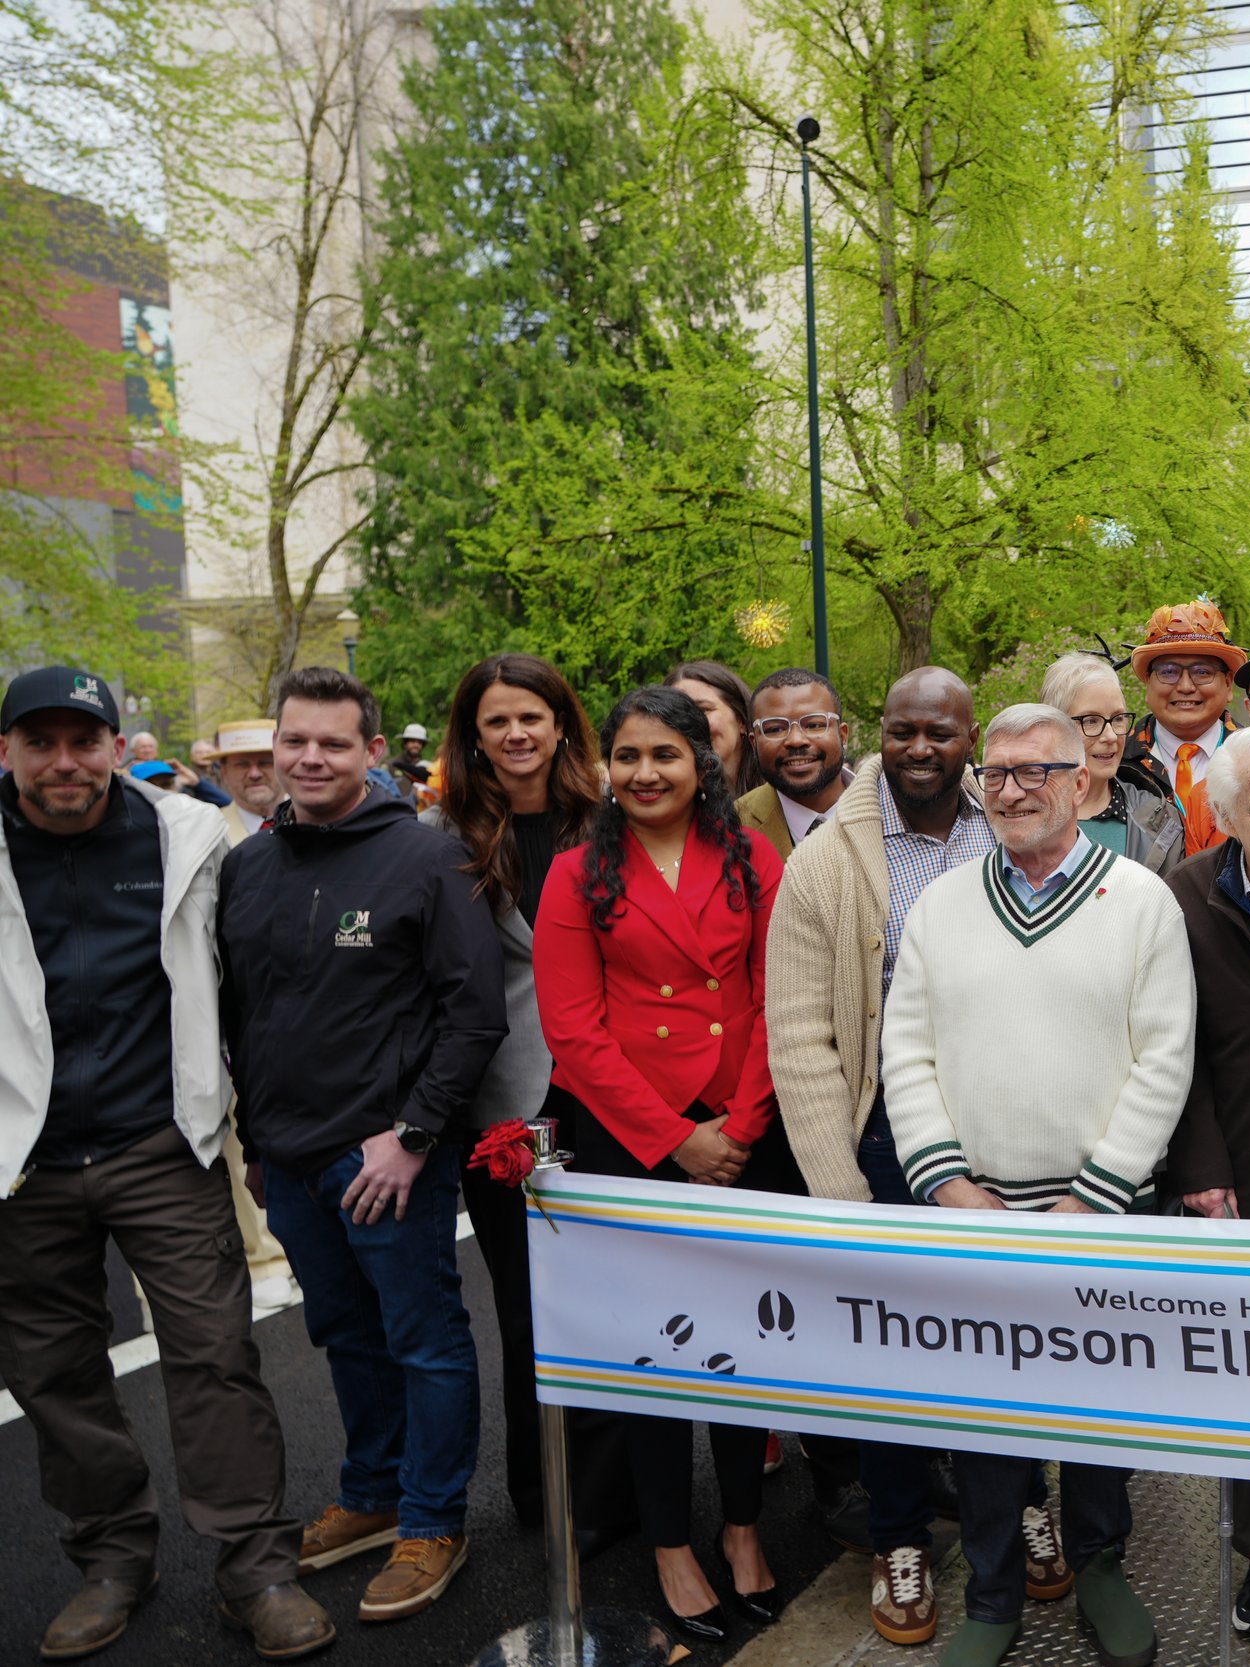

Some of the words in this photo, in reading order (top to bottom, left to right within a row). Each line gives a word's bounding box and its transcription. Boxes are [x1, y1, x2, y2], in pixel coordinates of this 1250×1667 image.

[335, 932, 356, 943] Cedar
[357, 932, 372, 943] Mill
[1075, 1287, 1227, 1317] Welcome
[835, 1295, 1156, 1371] Thompson
